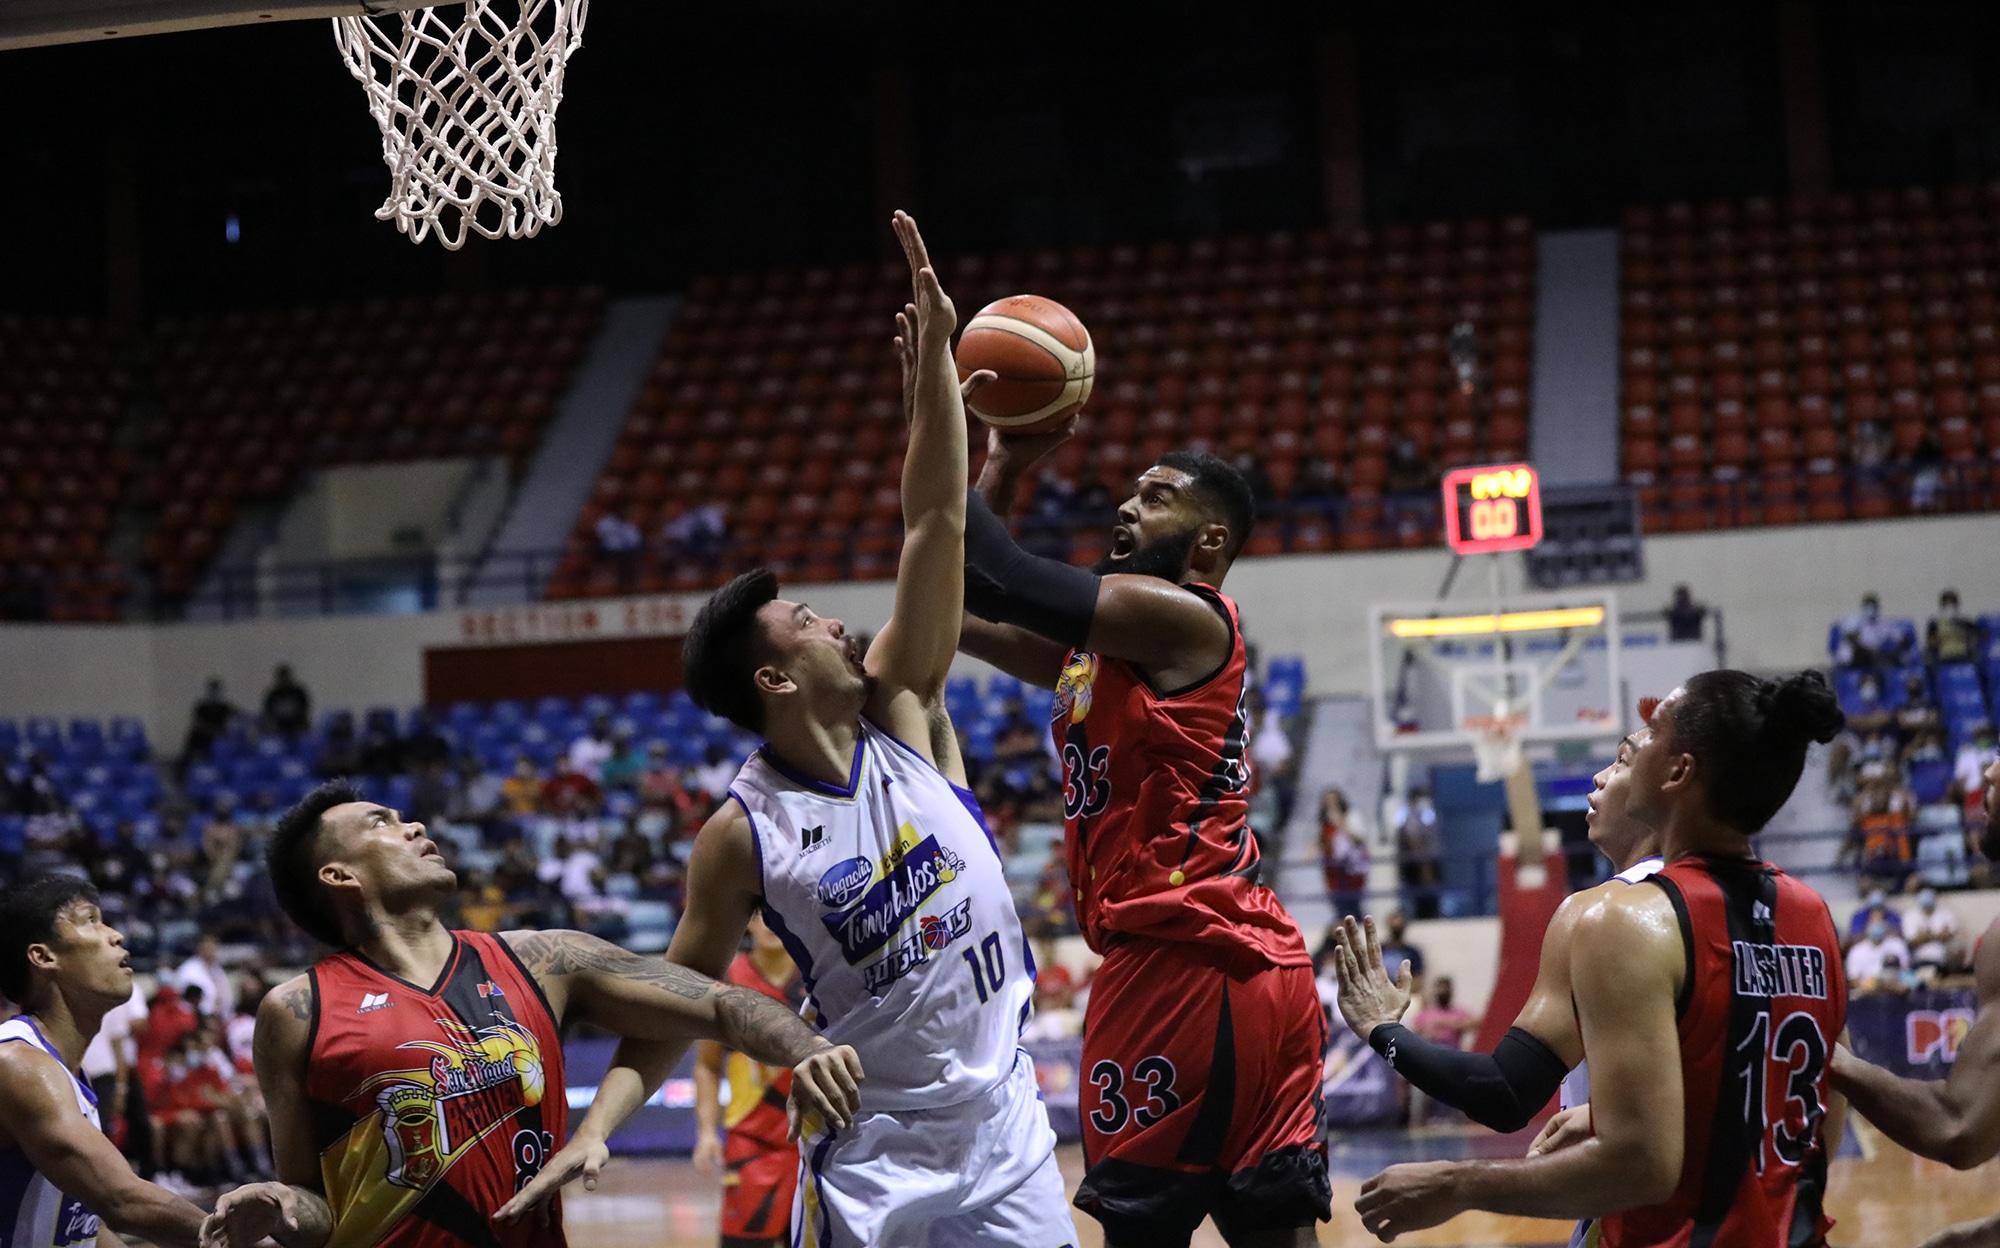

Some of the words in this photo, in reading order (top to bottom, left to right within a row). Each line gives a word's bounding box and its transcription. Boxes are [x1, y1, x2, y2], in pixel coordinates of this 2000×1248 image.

[1063, 743, 1112, 820] 33
[799, 835, 832, 858] MACBETH
[818, 857, 872, 904] Magnolia
[962, 930, 1006, 1006] 10
[1732, 940, 1828, 1000] LASSITER
[431, 1056, 466, 1095] San
[463, 1052, 517, 1089] Miguel
[1089, 1055, 1182, 1135] 33
[1736, 1010, 1828, 1177] 13
[511, 1128, 554, 1196] 8
